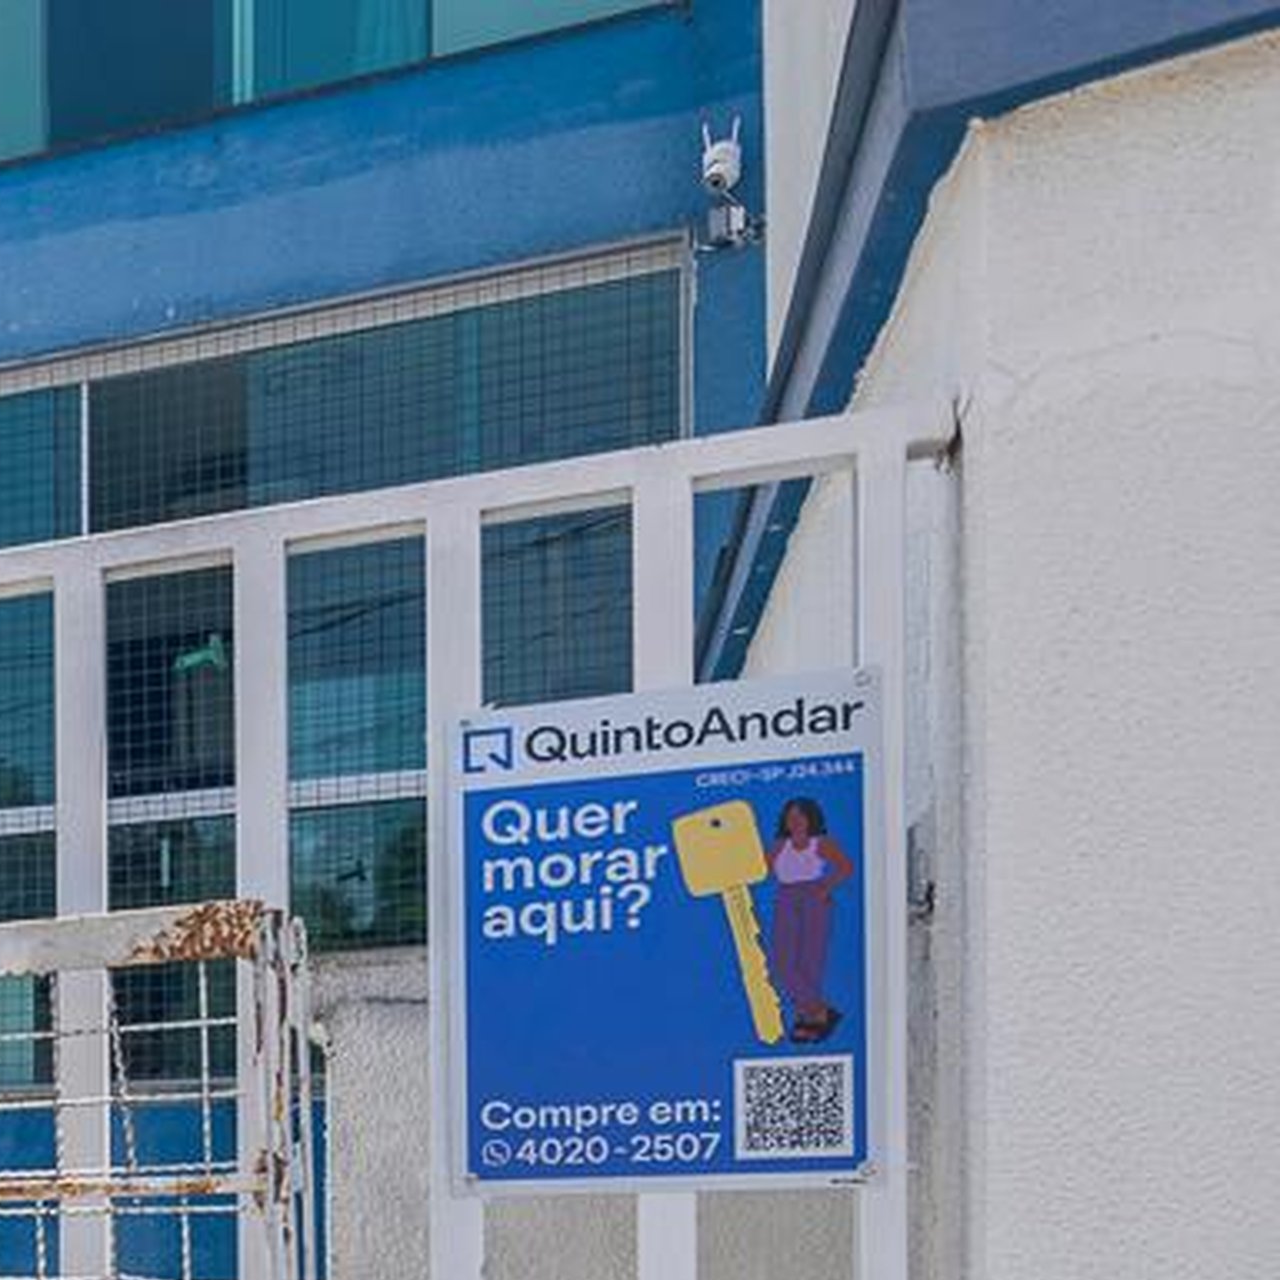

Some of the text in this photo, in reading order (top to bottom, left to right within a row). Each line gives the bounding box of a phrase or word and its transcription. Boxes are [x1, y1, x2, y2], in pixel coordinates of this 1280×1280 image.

[525, 697, 864, 762] QuintoAndar
[481, 799, 638, 845] Quer
[483, 845, 668, 892] morar
[482, 883, 651, 945] aqui?
[480, 1100, 722, 1133] Compre em:
[515, 1132, 721, 1166] 4020-2507
